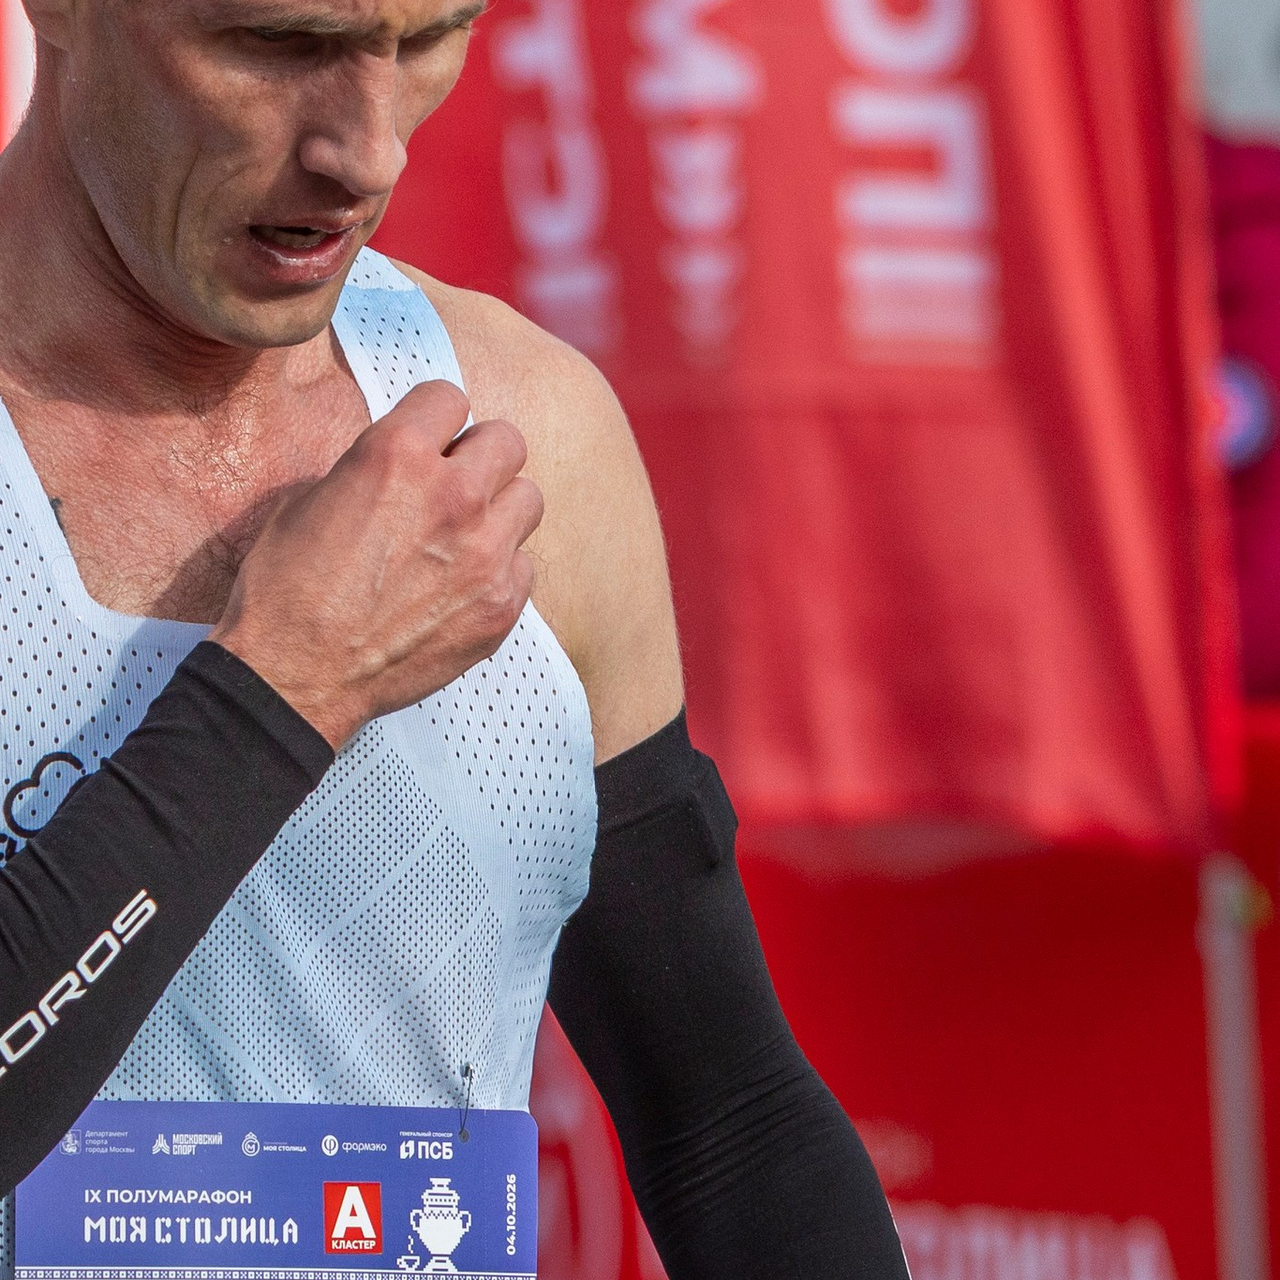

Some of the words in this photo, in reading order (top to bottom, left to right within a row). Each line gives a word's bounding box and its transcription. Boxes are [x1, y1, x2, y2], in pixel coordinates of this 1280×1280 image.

[84, 1130, 129, 1138] Департамент
[172, 1132, 223, 1145] МОСКОВСКИЙ
[109, 1146, 135, 1154] Москвы
[172, 1144, 196, 1155] СПОРТ
[278, 1145, 307, 1153] СТОЛИЦА
[342, 1141, 387, 1153] формэко
[418, 1141, 454, 1160] ПСБ
[84, 1189, 101, 1203] IX
[106, 1189, 252, 1204] ПОЛУМАРАФОН
[506, 1174, 517, 1256] 04.10.2026
[84, 1216, 146, 1243] МОЯ
[155, 1217, 298, 1246] СТОЛИЦА
[331, 1239, 376, 1250] КЛАСТЕР
